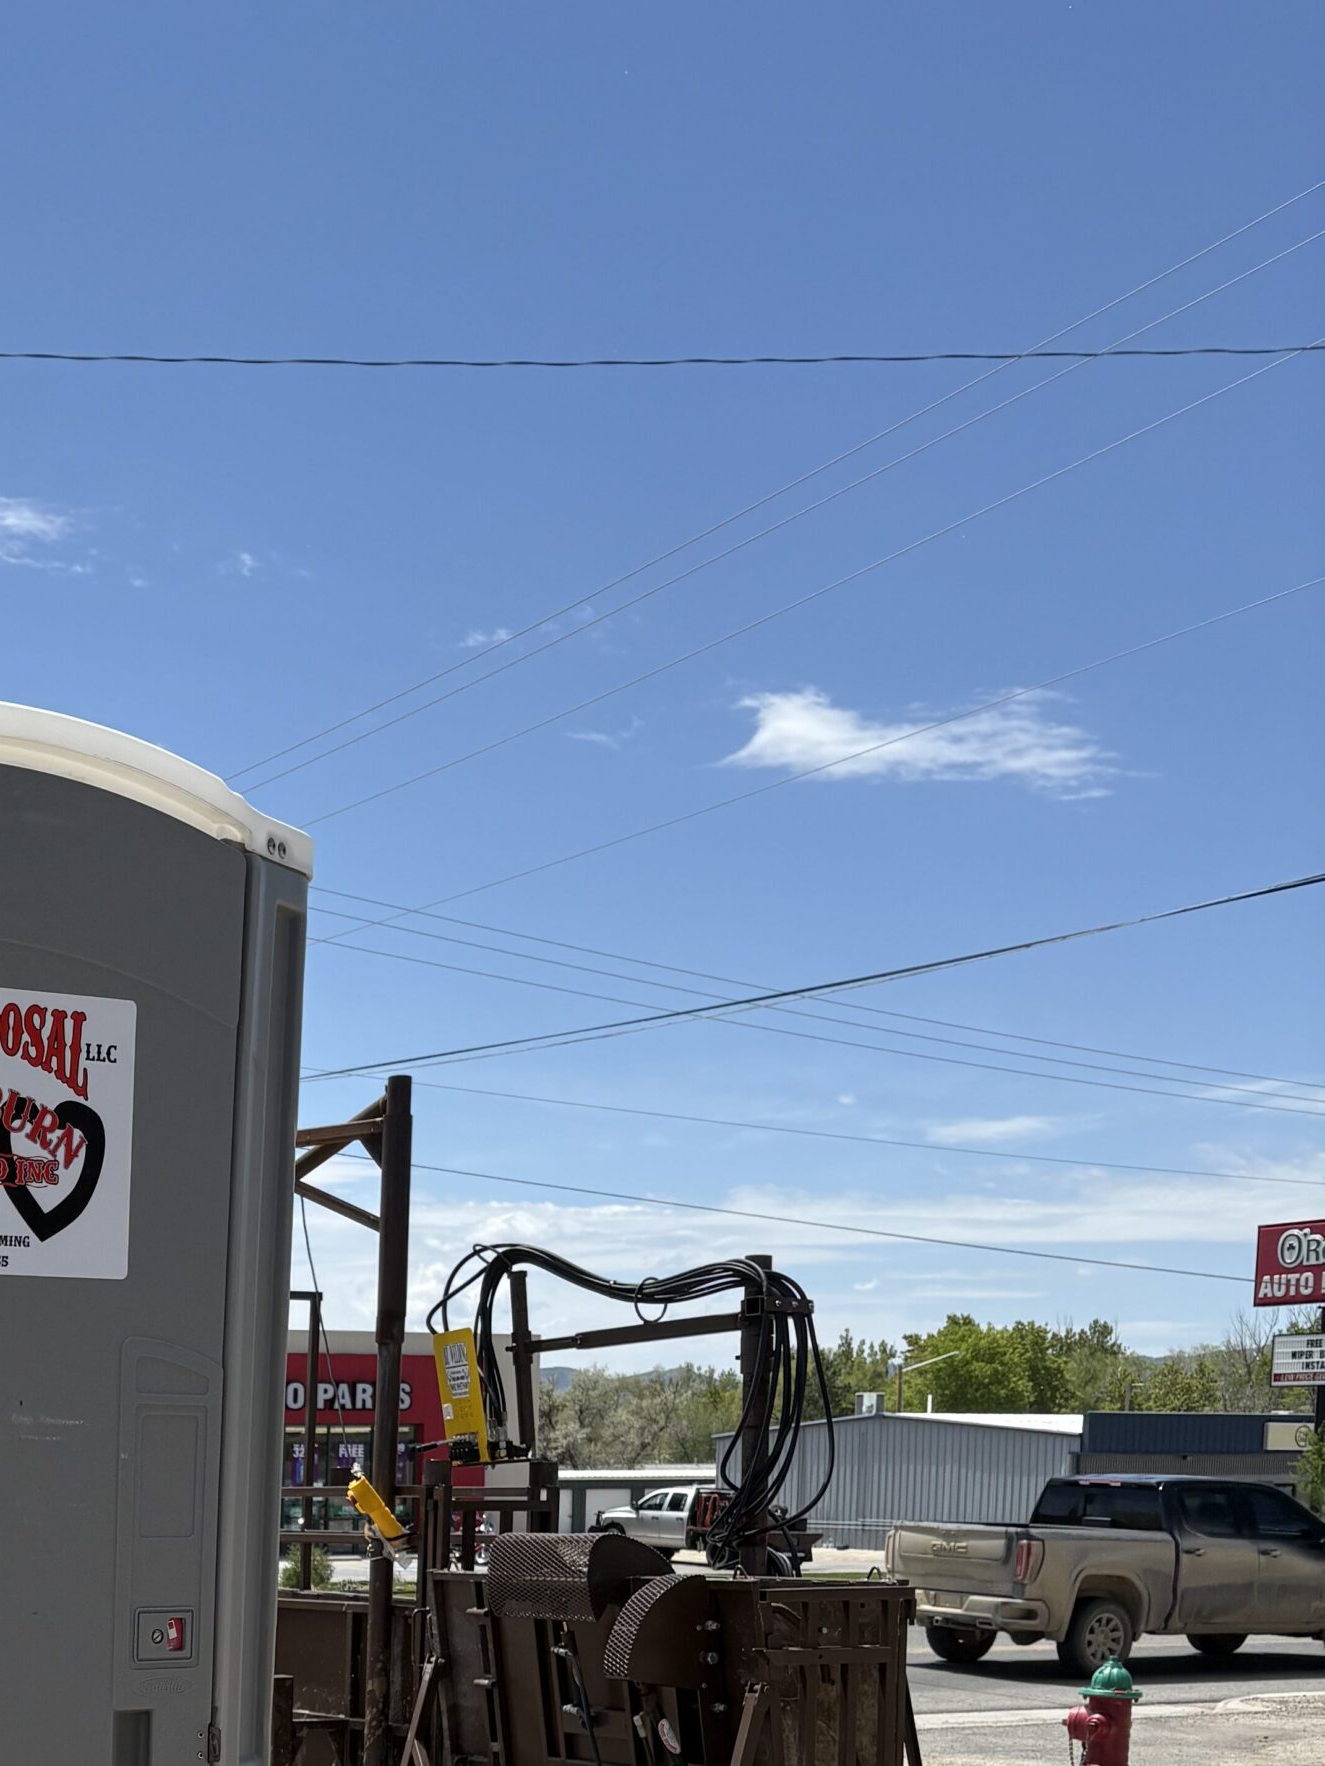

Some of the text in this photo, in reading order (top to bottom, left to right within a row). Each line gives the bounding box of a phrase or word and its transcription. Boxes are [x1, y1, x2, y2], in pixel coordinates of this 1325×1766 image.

[85, 1043, 117, 1063] LLC
[15, 1158, 59, 1185] INC
[1277, 1228, 1325, 1268] O'R
[1258, 1271, 1315, 1298] AUTO
[1291, 1350, 1314, 1360] WIPER
[1306, 1339, 1323, 1348] FREE
[316, 1383, 411, 1410] PARS
[931, 1541, 968, 1554] GMC
